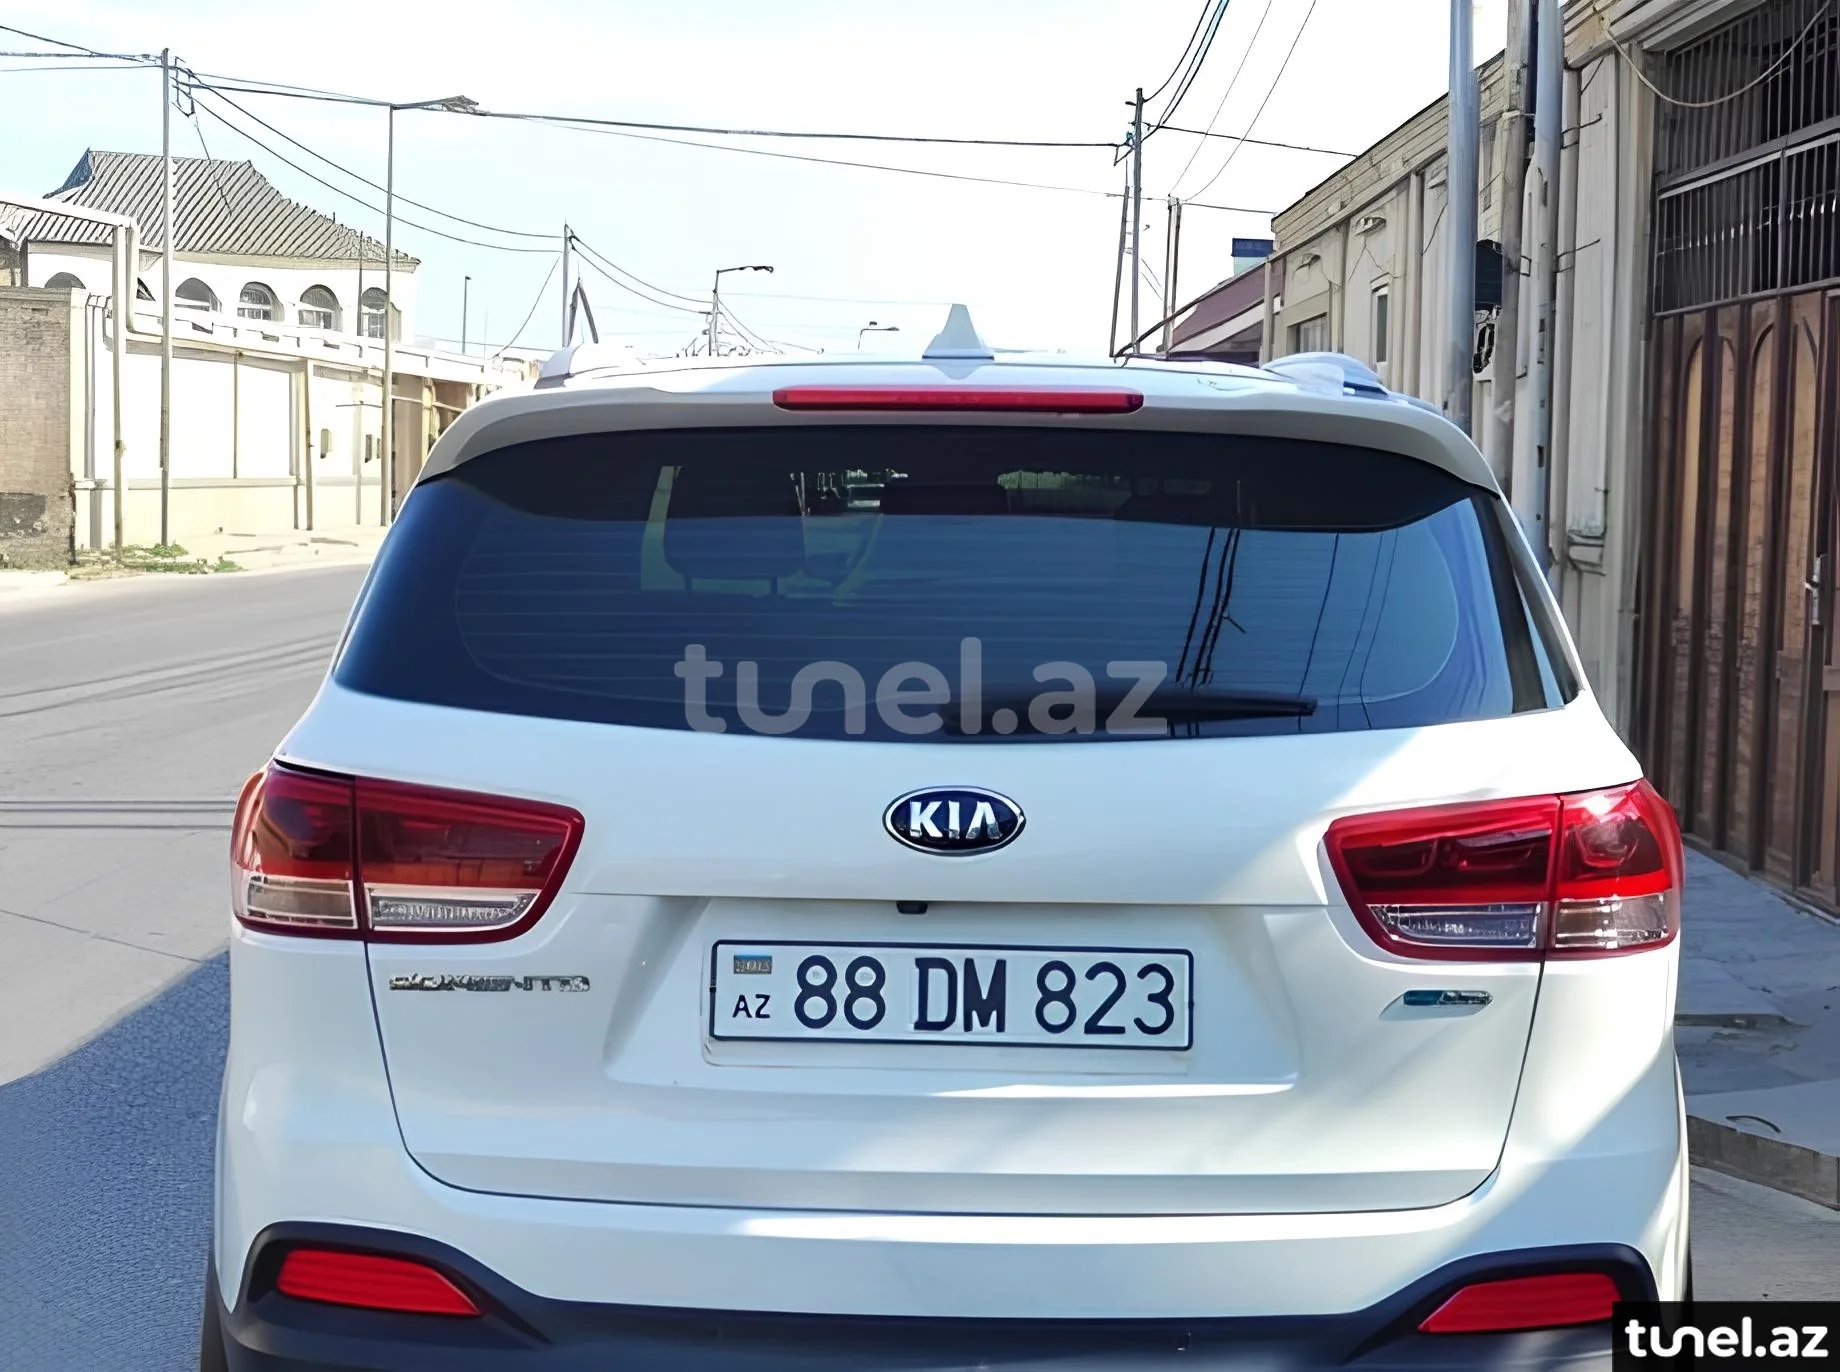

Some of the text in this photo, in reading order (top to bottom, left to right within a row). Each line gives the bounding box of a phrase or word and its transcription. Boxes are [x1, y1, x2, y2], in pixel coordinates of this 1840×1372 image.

[909, 800, 1003, 840] KIA
[732, 954, 1175, 1035] AZ 88 DM 823
